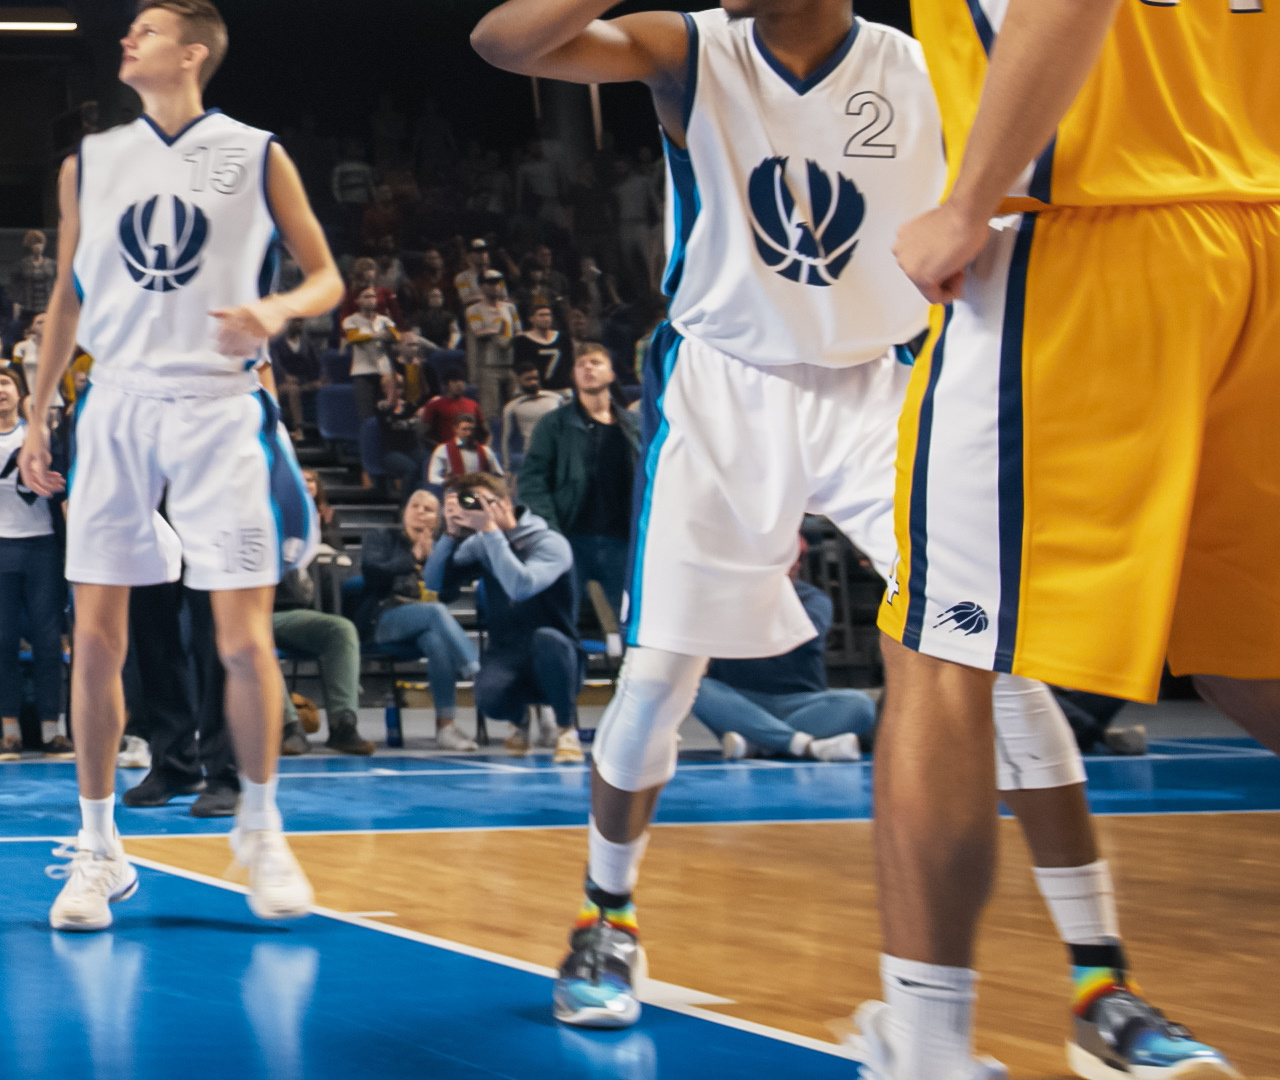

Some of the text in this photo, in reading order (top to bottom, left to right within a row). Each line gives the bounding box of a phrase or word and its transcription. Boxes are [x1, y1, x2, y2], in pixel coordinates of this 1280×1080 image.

[843, 90, 897, 159] 2
[181, 146, 250, 195] 15
[538, 348, 561, 380] 7
[210, 527, 266, 575] 15
